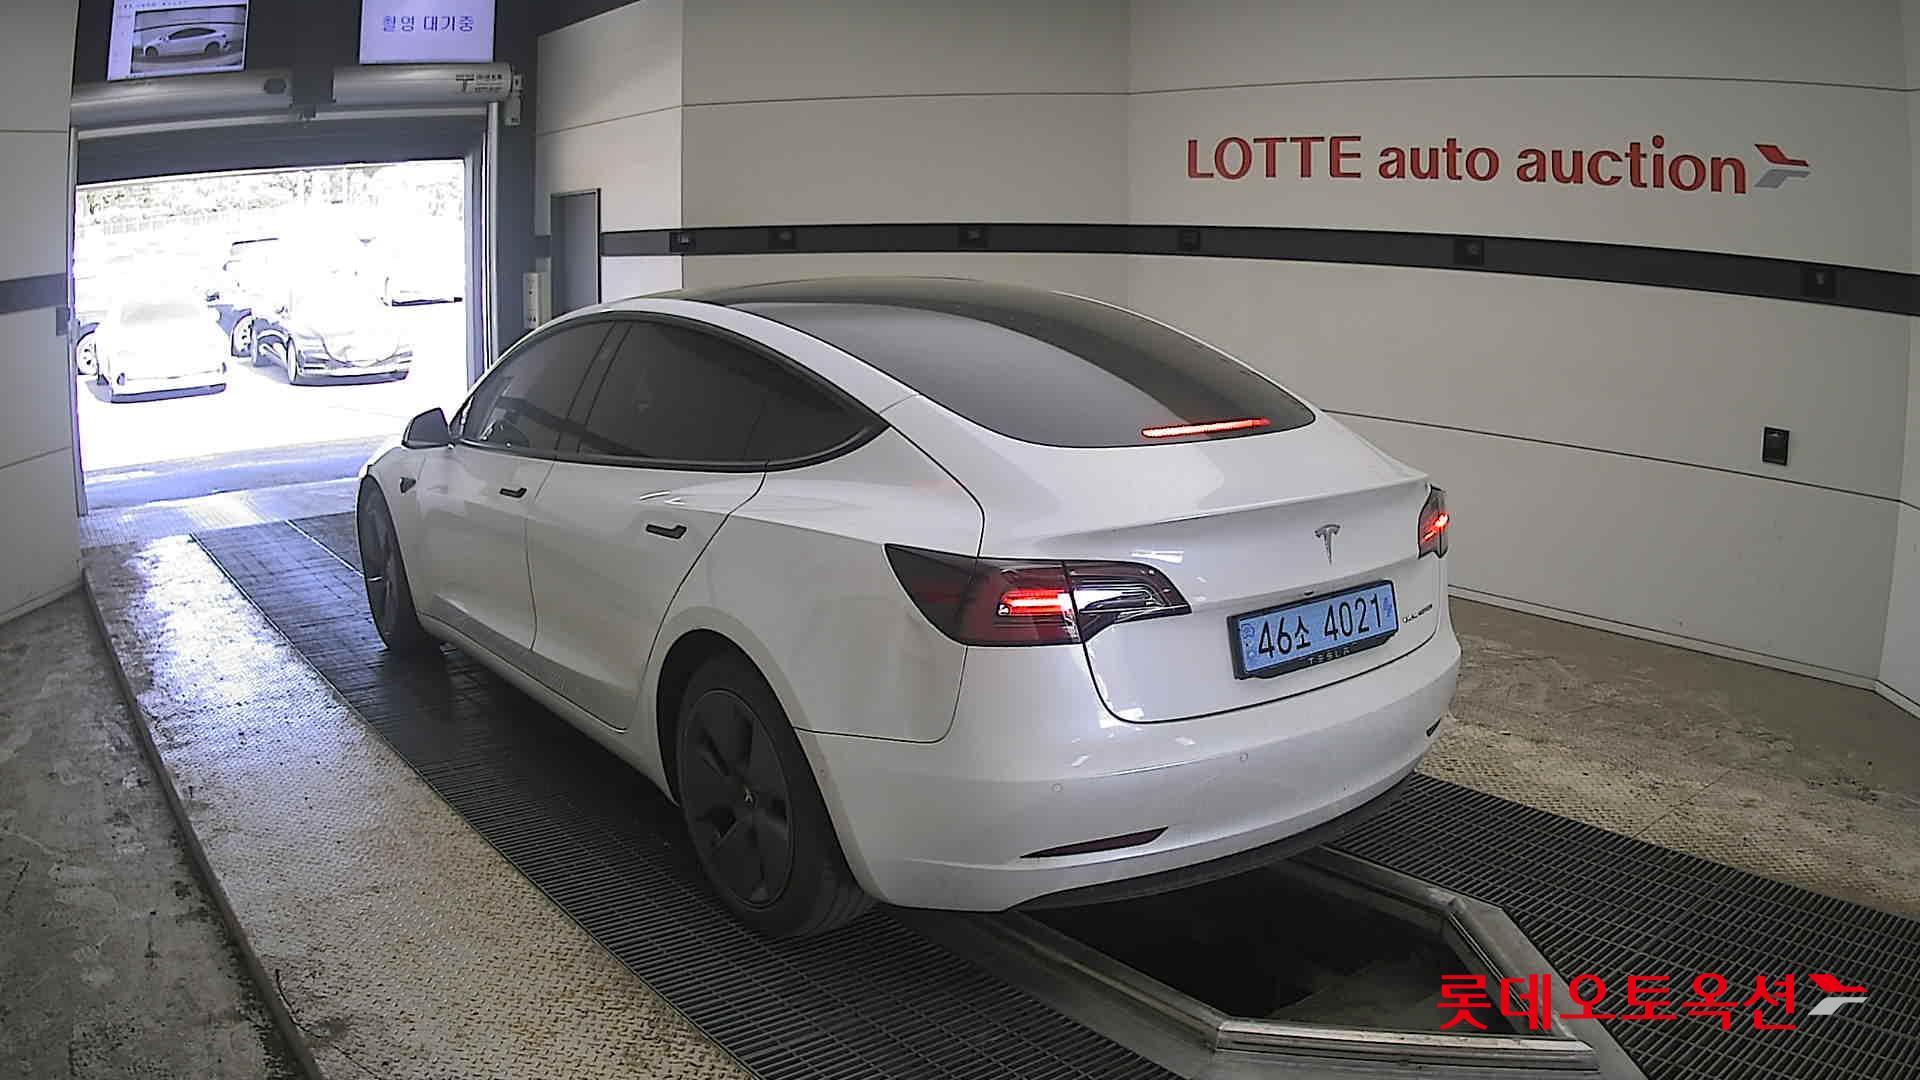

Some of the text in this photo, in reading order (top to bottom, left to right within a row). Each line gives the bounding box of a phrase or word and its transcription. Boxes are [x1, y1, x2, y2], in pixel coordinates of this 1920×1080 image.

[423, 15, 473, 32] 대기중
[1187, 135, 1746, 194] LOTTE auto auction
[1257, 615, 1312, 659] 46소
[1323, 593, 1383, 641] 4021
[1307, 647, 1351, 665] TESLA
